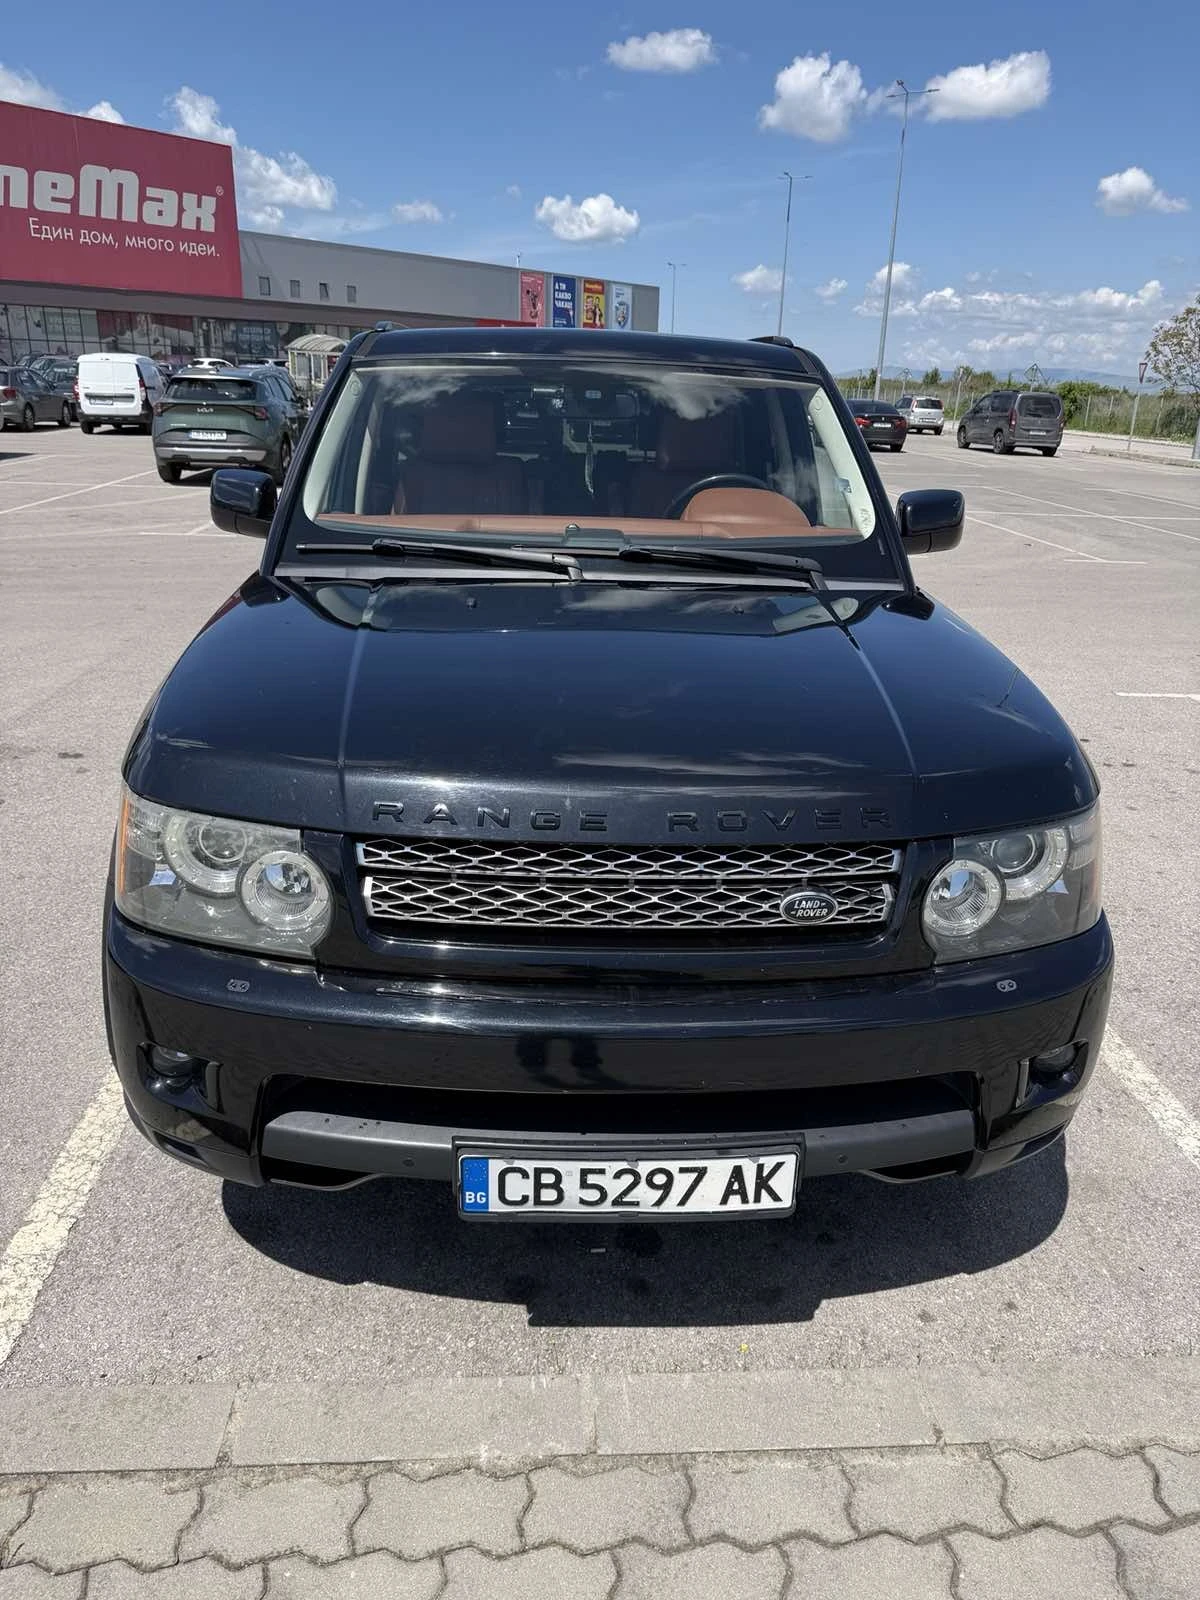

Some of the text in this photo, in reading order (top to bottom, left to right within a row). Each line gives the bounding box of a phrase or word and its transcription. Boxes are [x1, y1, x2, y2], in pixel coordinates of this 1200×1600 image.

[29, 217, 221, 257] Един дом, много идеи.
[372, 800, 890, 833] RANGE ROVER
[465, 1192, 487, 1204] BG
[497, 1161, 786, 1208] CB 5297 AK
